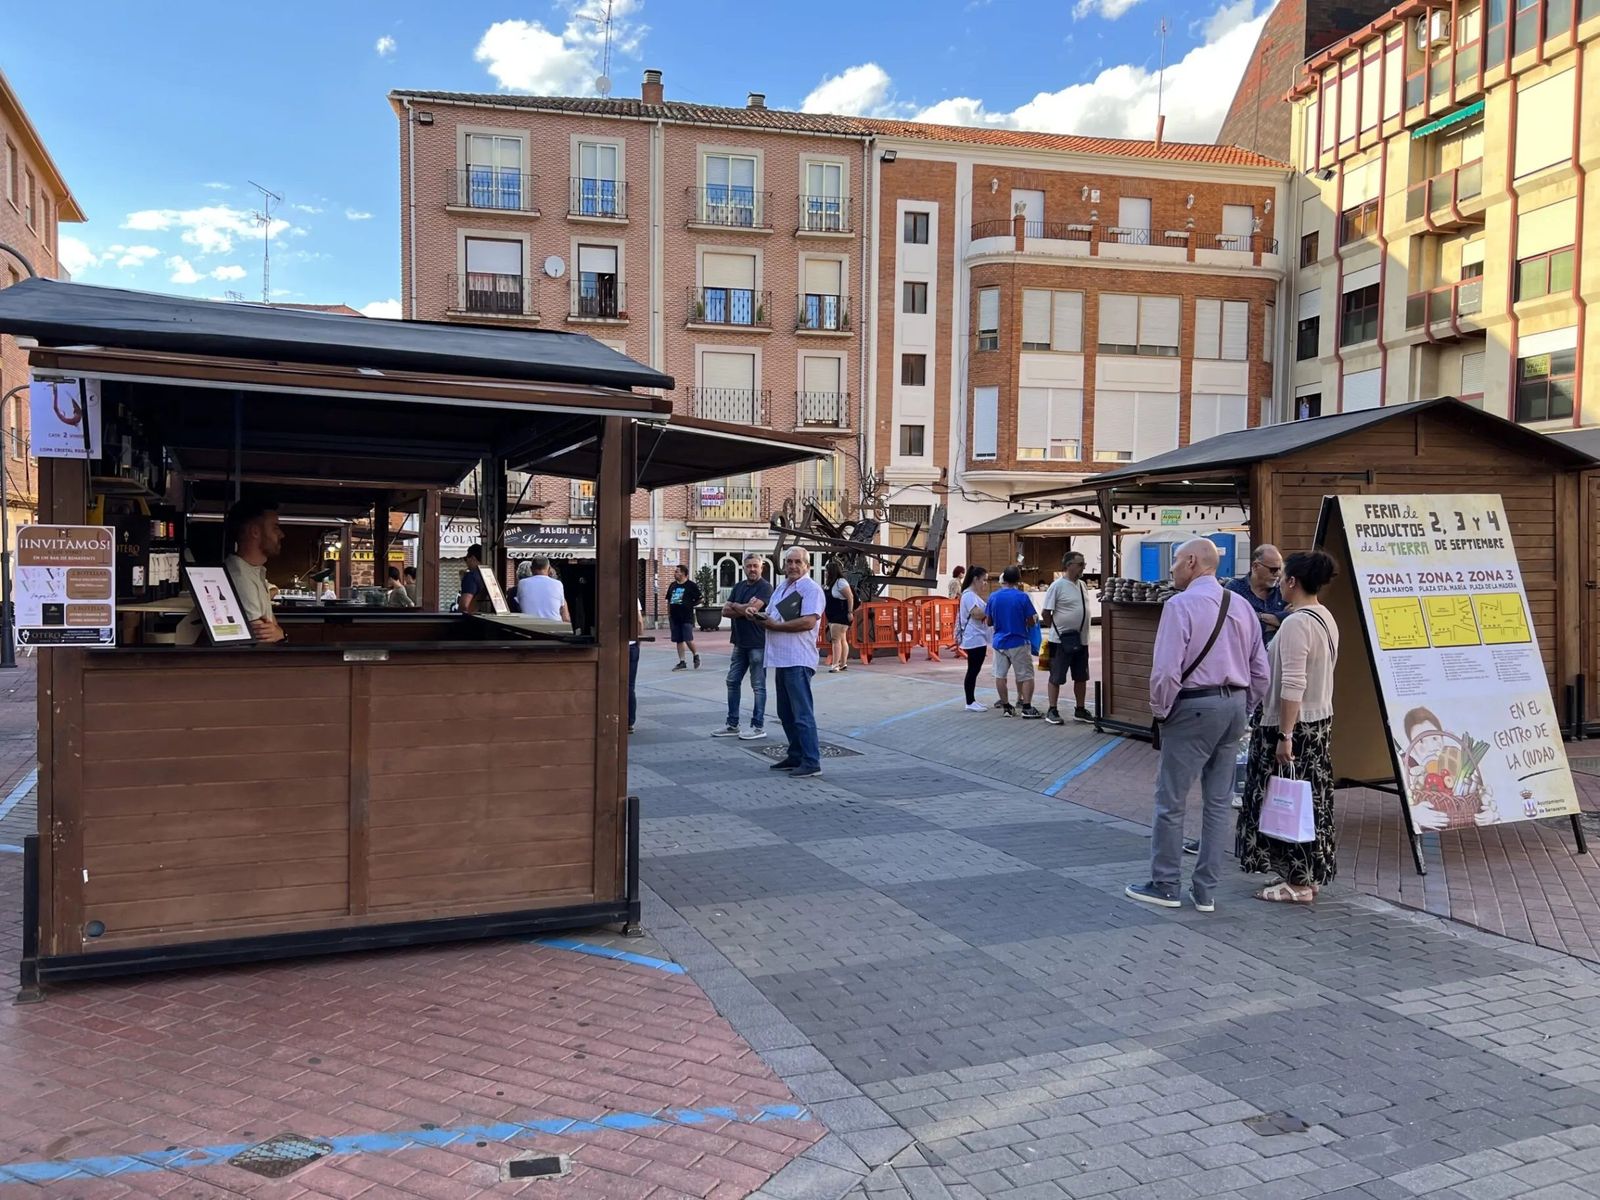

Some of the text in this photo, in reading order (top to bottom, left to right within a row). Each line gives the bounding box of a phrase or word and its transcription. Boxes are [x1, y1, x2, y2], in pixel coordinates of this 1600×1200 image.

[1364, 503, 1419, 519] FERIA de
[440, 524, 481, 533] URROS
[1428, 511, 1447, 535] 2,
[1453, 511, 1466, 531] 3
[1486, 510, 1501, 531] 4
[569, 527, 580, 535] DE
[581, 527, 592, 535] TE
[631, 528, 649, 536] NOS
[1355, 523, 1426, 538] PRODUCTOS
[440, 535, 478, 544] COLAT
[522, 533, 569, 544] Laura
[1434, 537, 1505, 551] DE SEPTIEMBRE
[1361, 541, 1430, 556] de la TIERRA
[1367, 573, 1412, 585] ZONA 1
[1417, 571, 1464, 584] ZONA 2
[1468, 570, 1514, 582] ZONA 3
[1510, 700, 1541, 720] EN EL
[1493, 722, 1549, 750] CENTRO DE
[1505, 746, 1555, 770] LA CIUDAD
